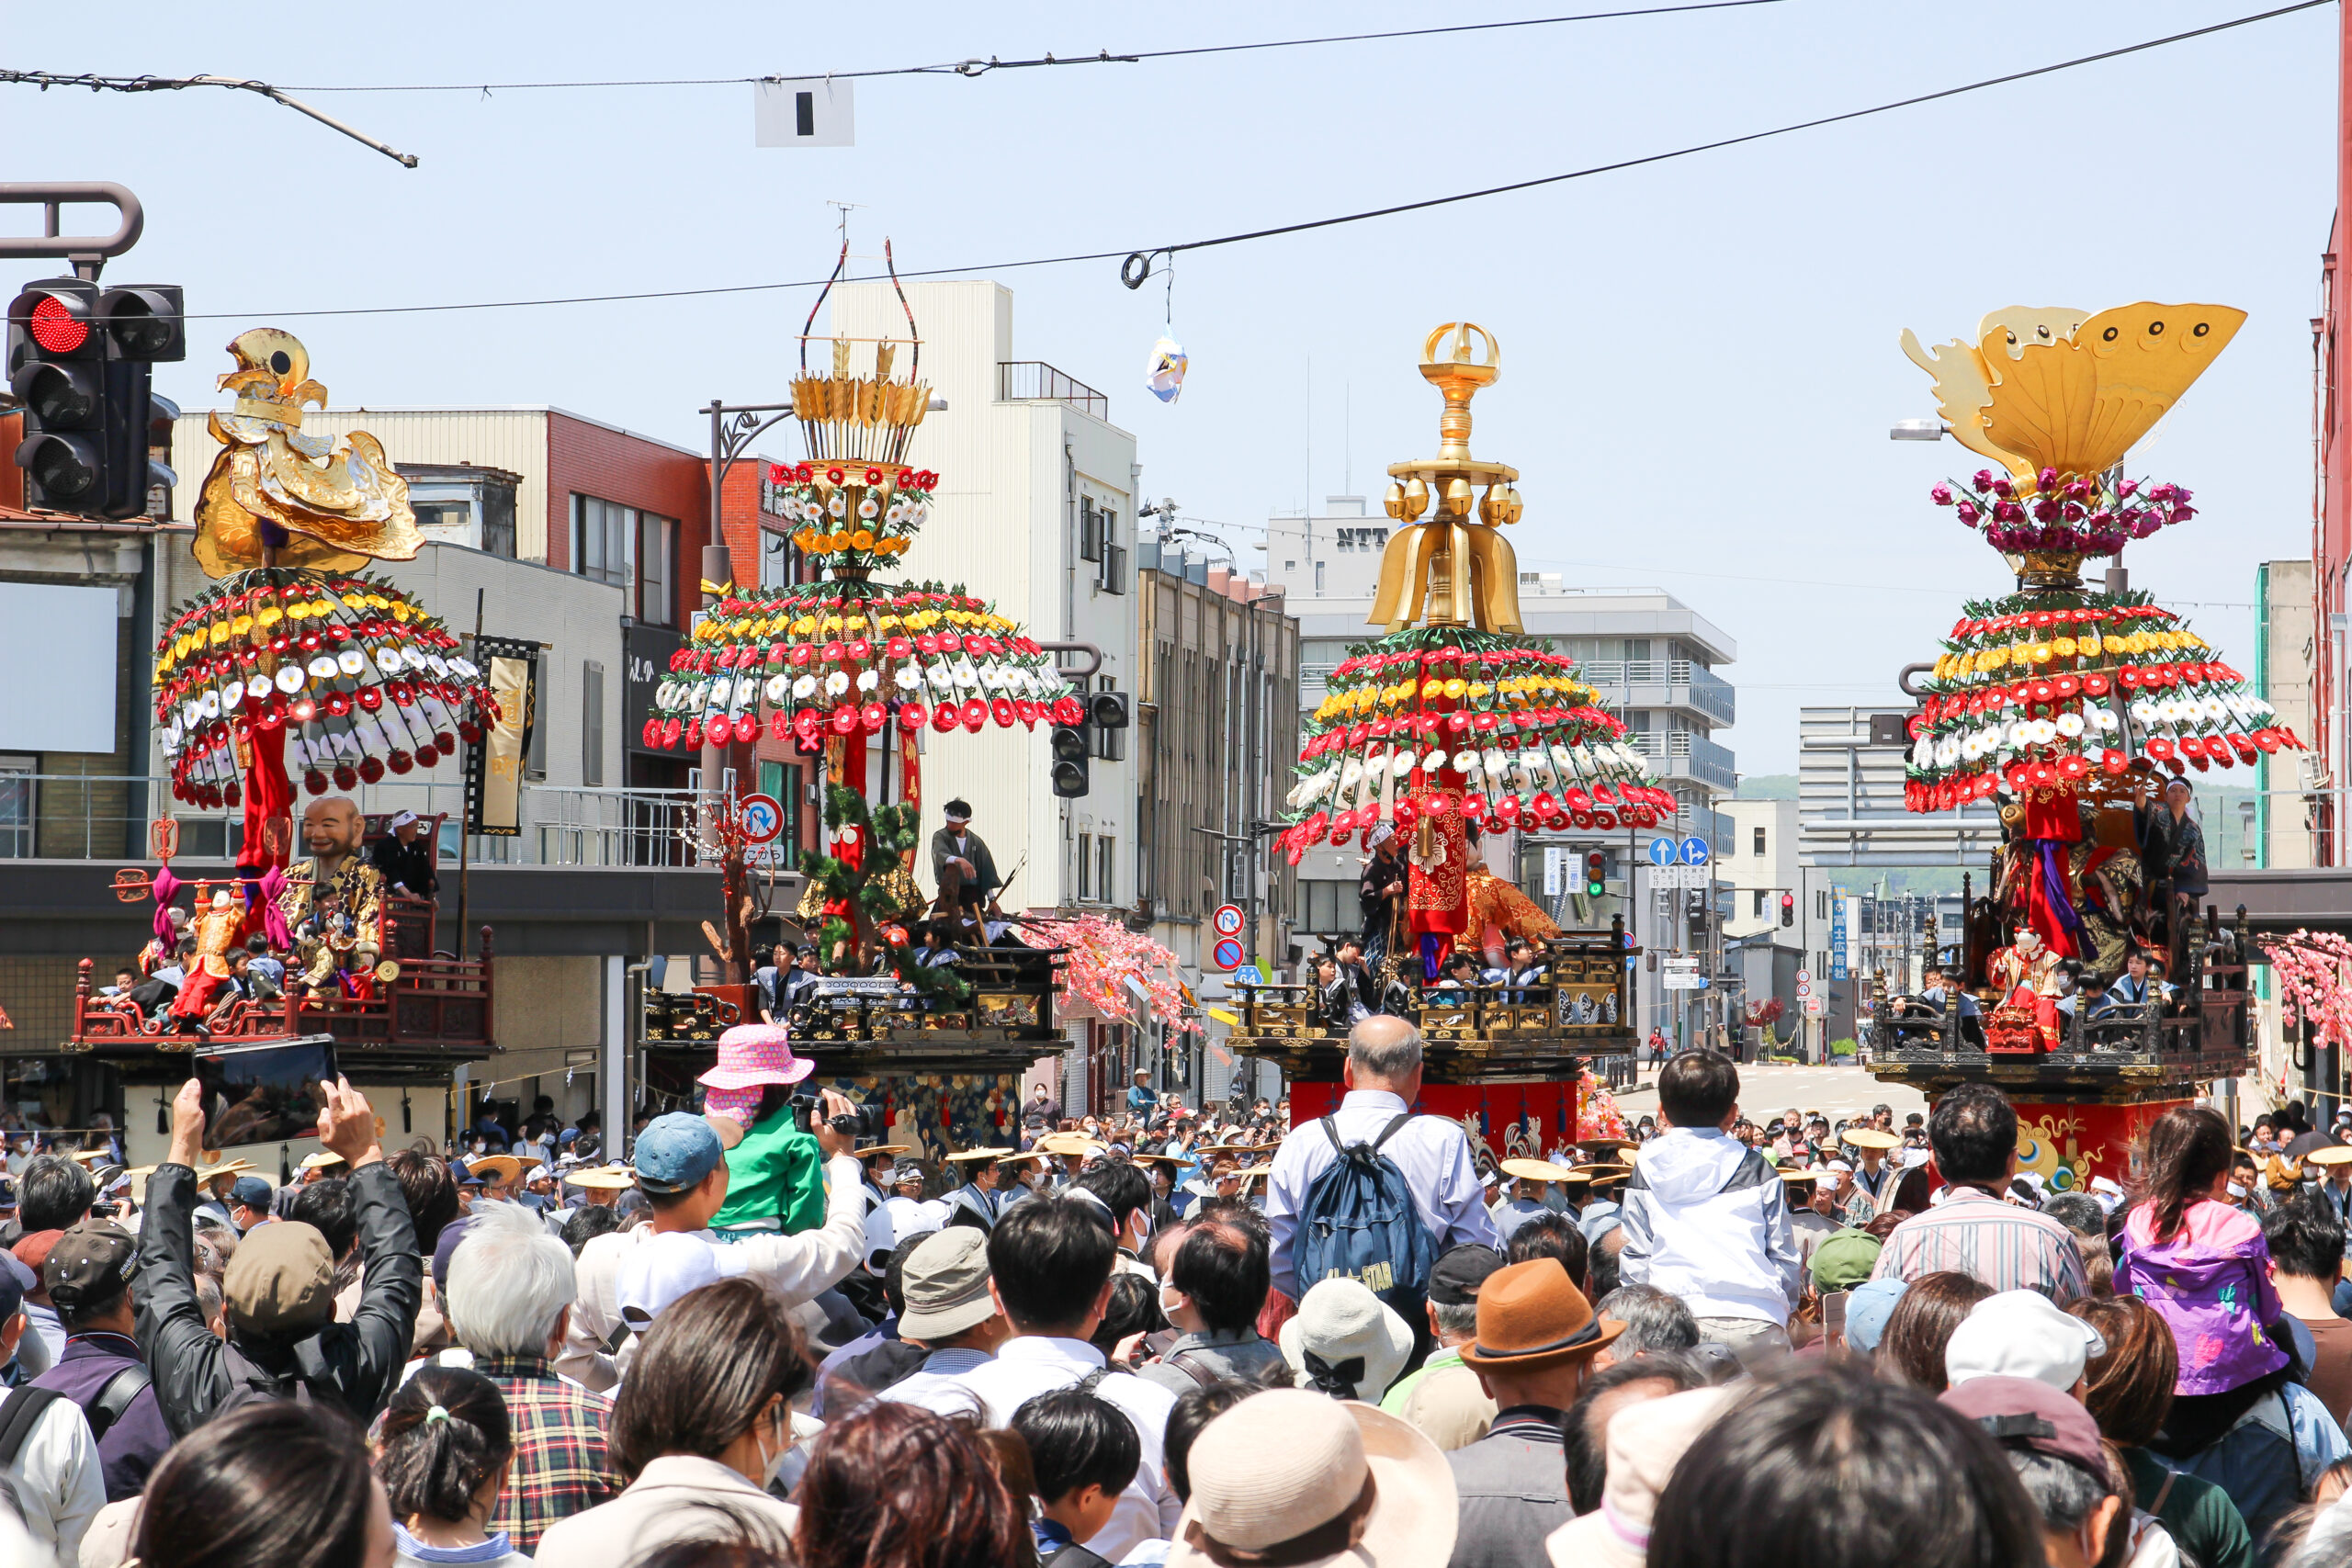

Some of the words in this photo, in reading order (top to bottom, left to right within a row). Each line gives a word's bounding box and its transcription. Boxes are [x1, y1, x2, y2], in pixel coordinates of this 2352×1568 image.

[1337, 528, 1388, 547] NTT
[745, 848, 781, 861] こから
[1834, 915, 1846, 979] 富士広告社
[1239, 974, 1257, 984] 64
[1362, 1260, 1394, 1292] STAR
